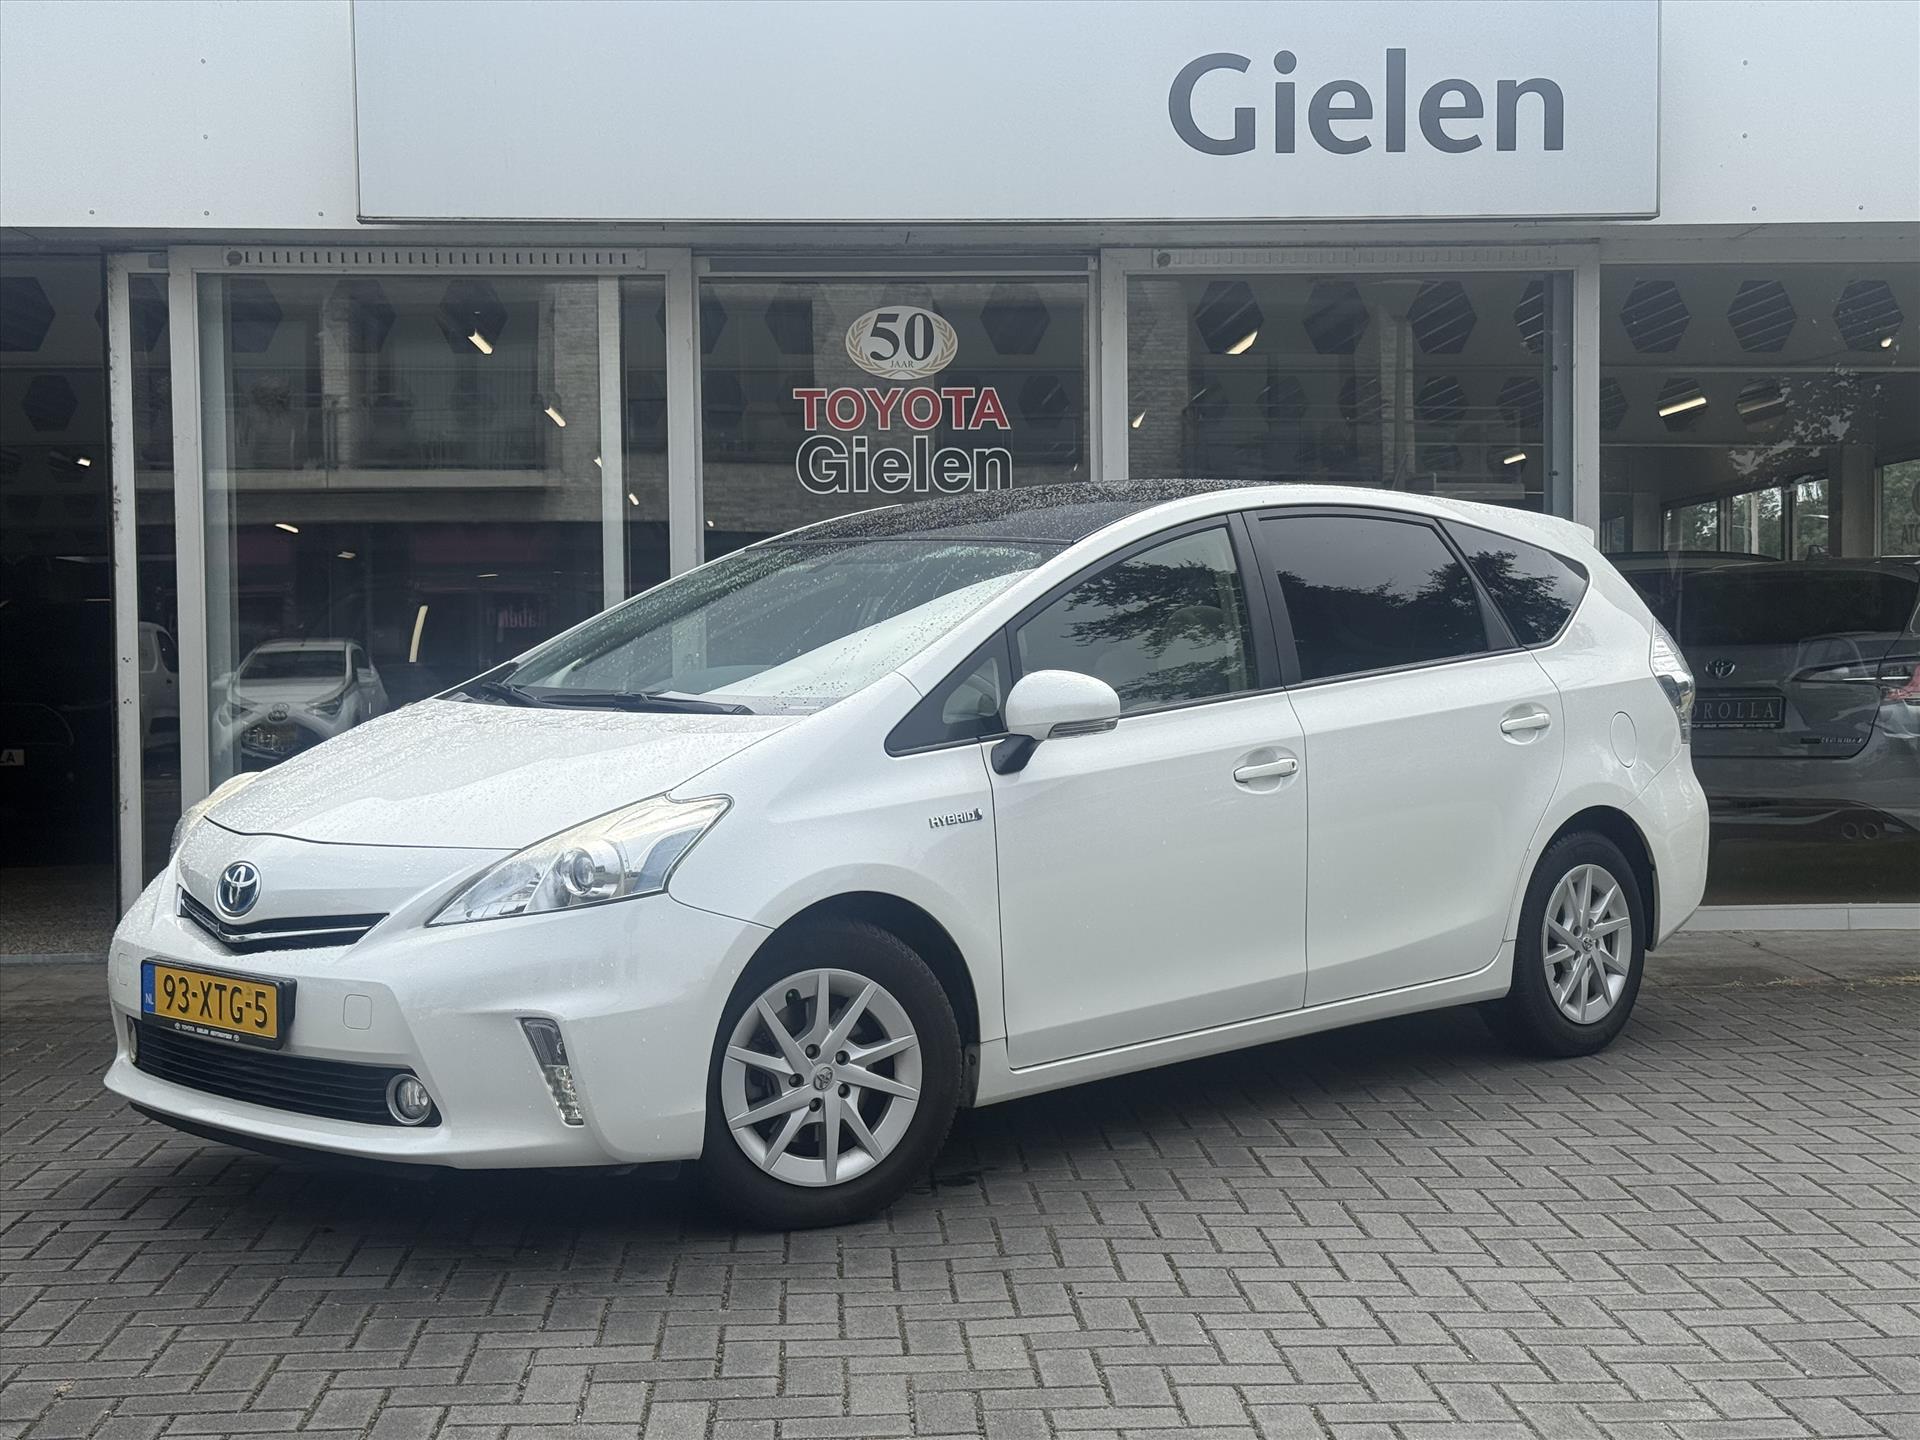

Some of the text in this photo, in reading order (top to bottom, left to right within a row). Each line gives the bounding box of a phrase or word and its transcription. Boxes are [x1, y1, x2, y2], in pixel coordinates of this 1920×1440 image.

[1168, 48, 1564, 155] Gielen
[869, 312, 935, 361] 50
[890, 360, 914, 369] JAAR
[793, 387, 1012, 431] TOYOTA
[796, 435, 1013, 494] Gielen
[929, 811, 976, 829] HYBRID
[145, 993, 154, 1005] NL
[163, 974, 268, 1029] 93-XTG-5
